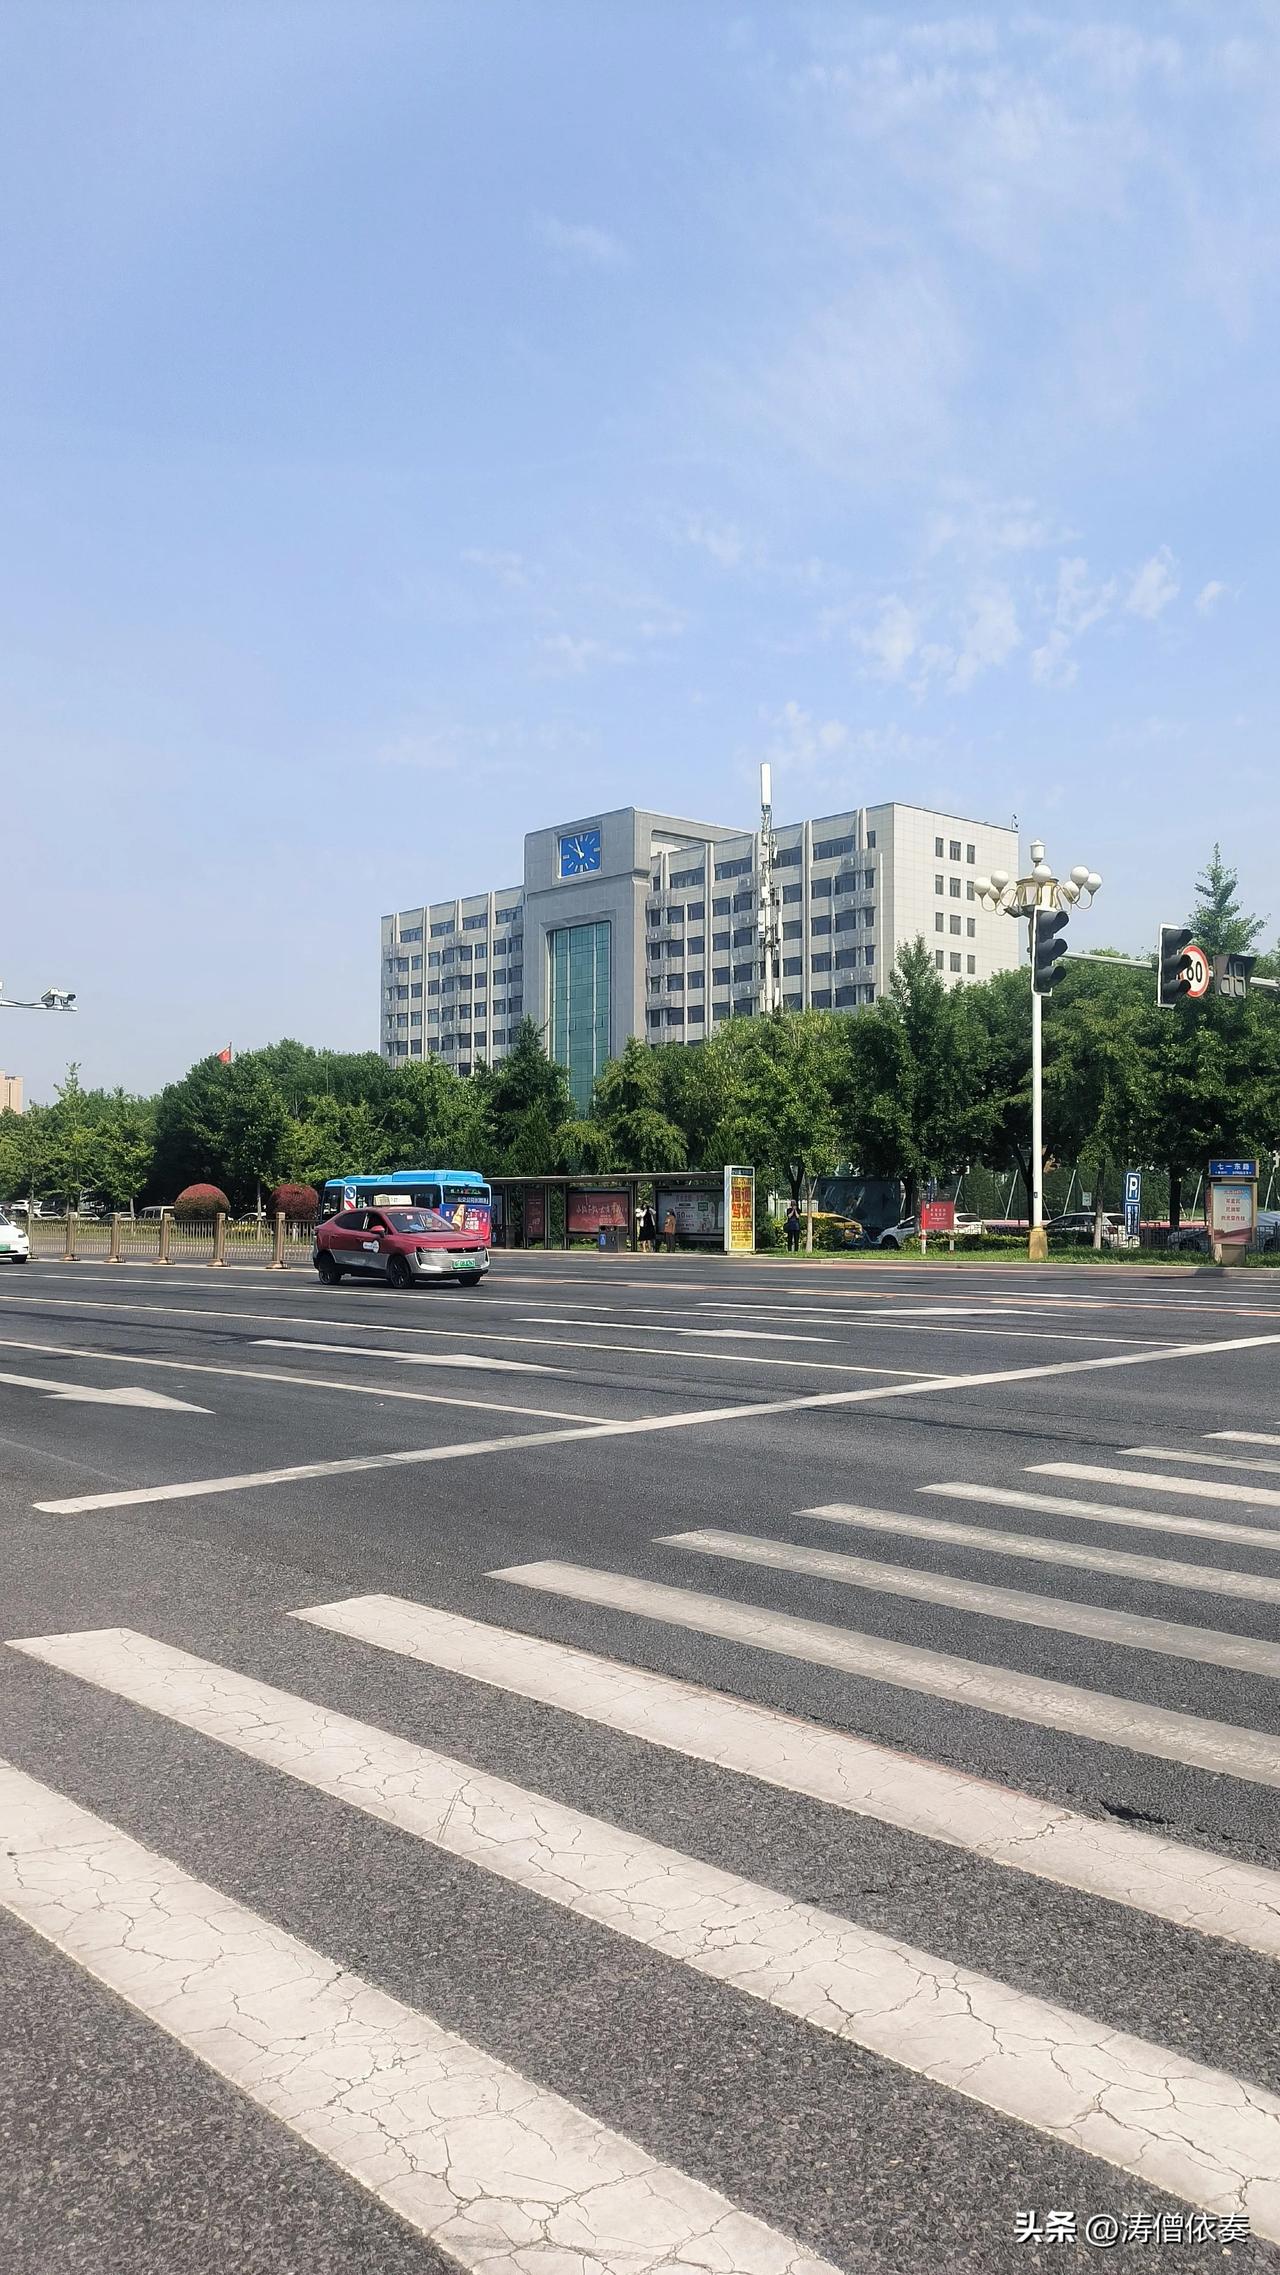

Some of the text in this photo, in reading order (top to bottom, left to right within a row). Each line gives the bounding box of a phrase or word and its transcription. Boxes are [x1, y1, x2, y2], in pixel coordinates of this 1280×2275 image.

[1187, 961, 1202, 983] 60
[1217, 1163, 1250, 1171] 七一东路
[1129, 1177, 1138, 1198] P
[731, 1202, 752, 1219] 驾校
